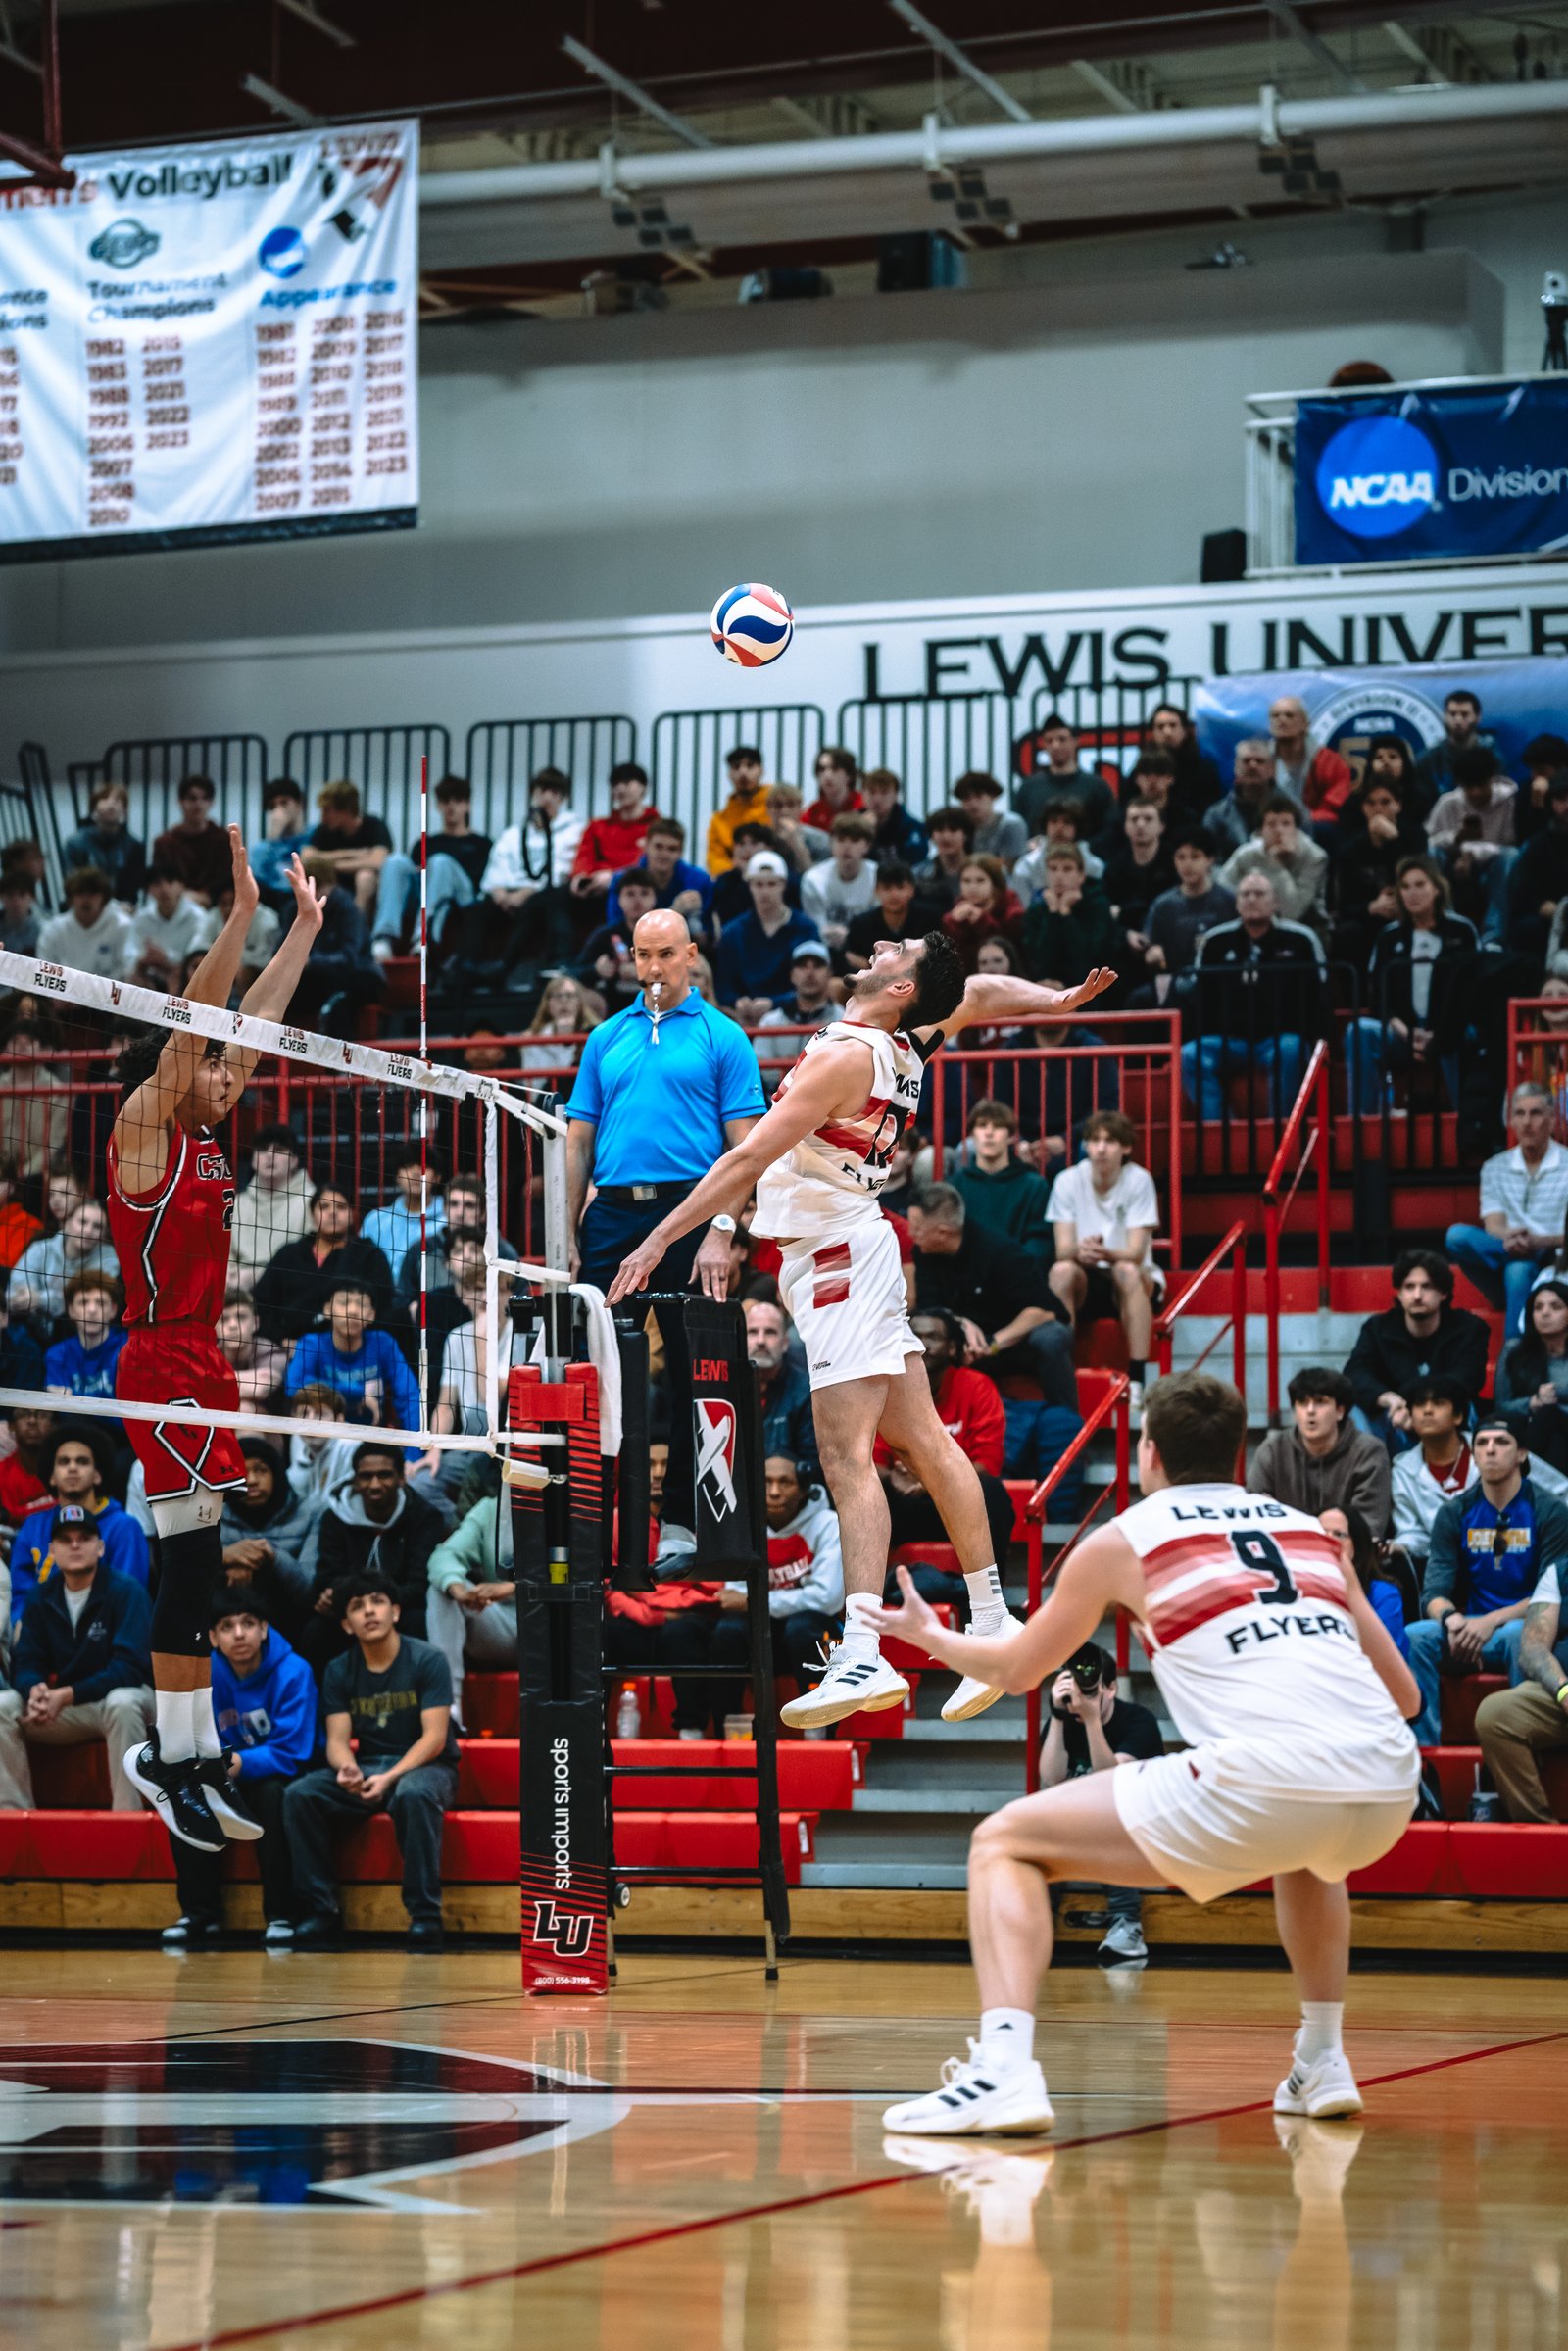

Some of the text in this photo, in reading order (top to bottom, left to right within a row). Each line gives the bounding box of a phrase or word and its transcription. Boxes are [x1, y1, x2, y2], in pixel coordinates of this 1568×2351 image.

[108, 154, 292, 200] Volleyball
[88, 298, 215, 323] Champions
[1330, 464, 1568, 509] NCAA Division
[863, 625, 1170, 702] LEWIS
[39, 961, 64, 977] LEWIS
[34, 973, 67, 992] FLYERS
[167, 996, 189, 1009] LEWIS
[162, 1007, 191, 1024] FLYERS
[279, 1037, 308, 1053] FLYERS
[693, 1358, 729, 1383] LEWIS
[1171, 1503, 1288, 1521] LEWIS
[1230, 1530, 1298, 1605] 9
[550, 1738, 572, 1890] sports imports
[532, 1900, 594, 1957] LU
